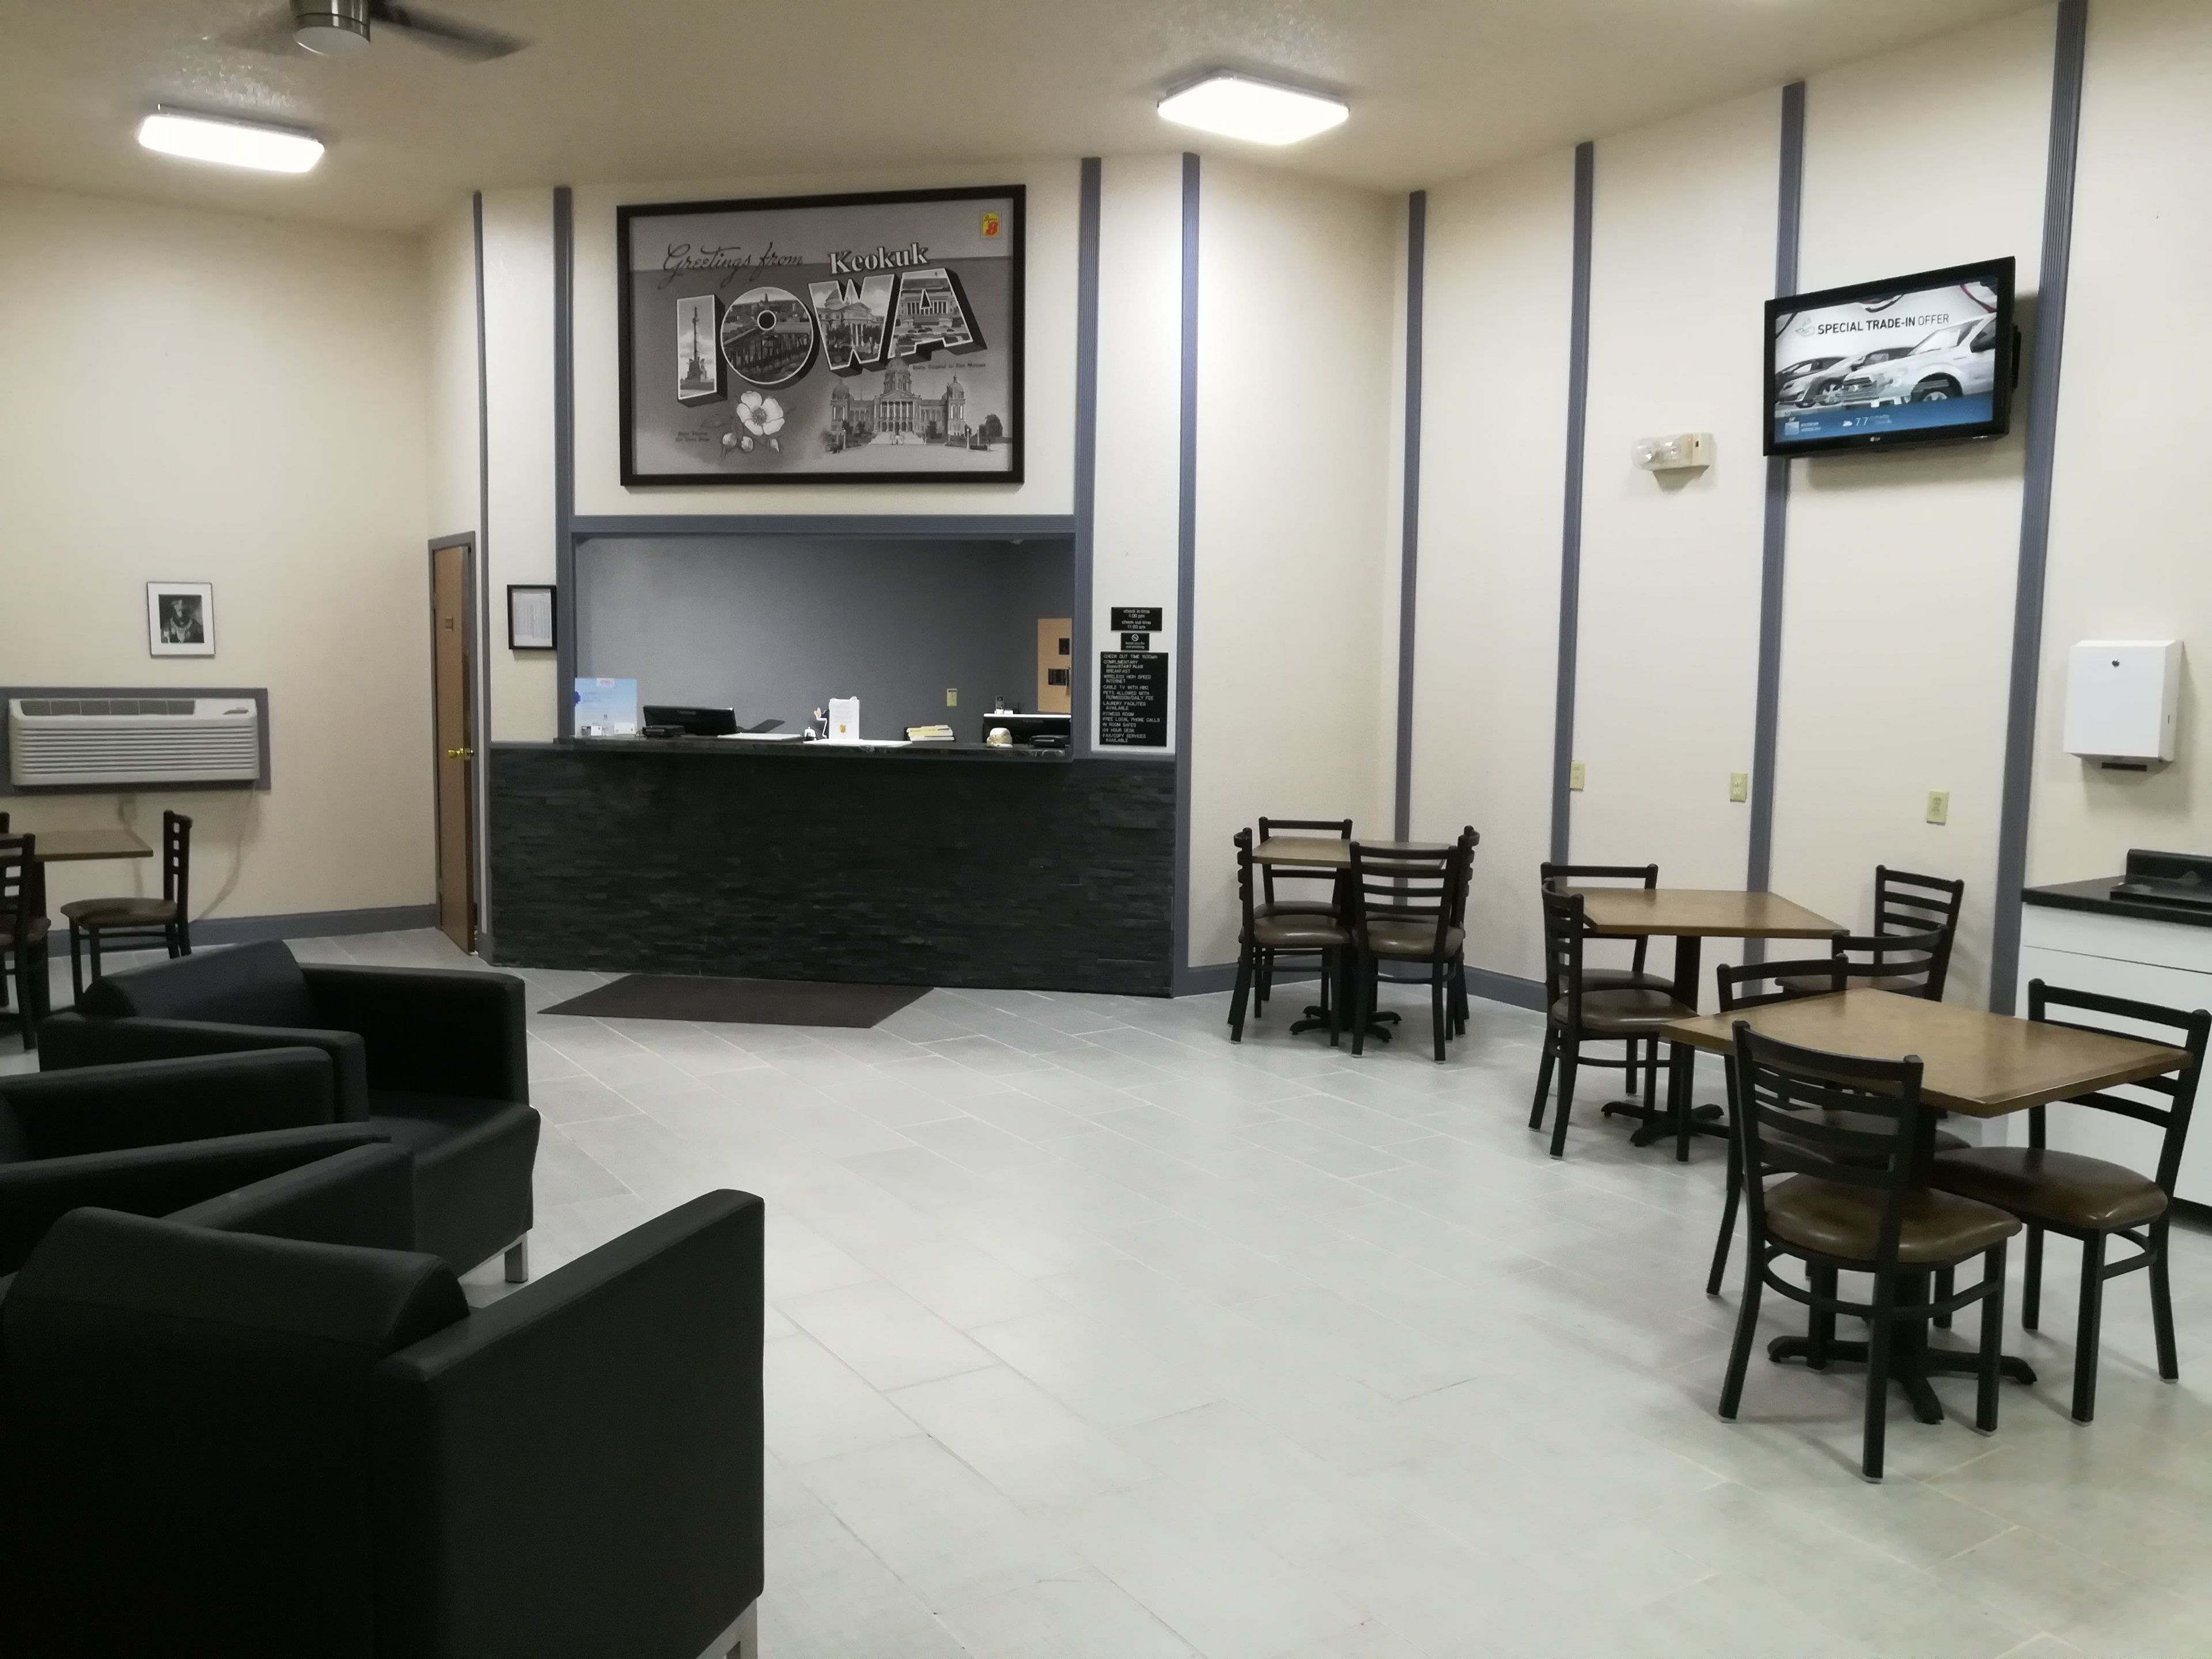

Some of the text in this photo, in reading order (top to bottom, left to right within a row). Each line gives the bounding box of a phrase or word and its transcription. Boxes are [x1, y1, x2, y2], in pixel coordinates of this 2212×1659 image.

[657, 241, 930, 287] Greetings from Keokuk
[677, 267, 985, 407] IOWA
[1817, 313, 1950, 335] SPECIAL TRADE-IN OFFER
